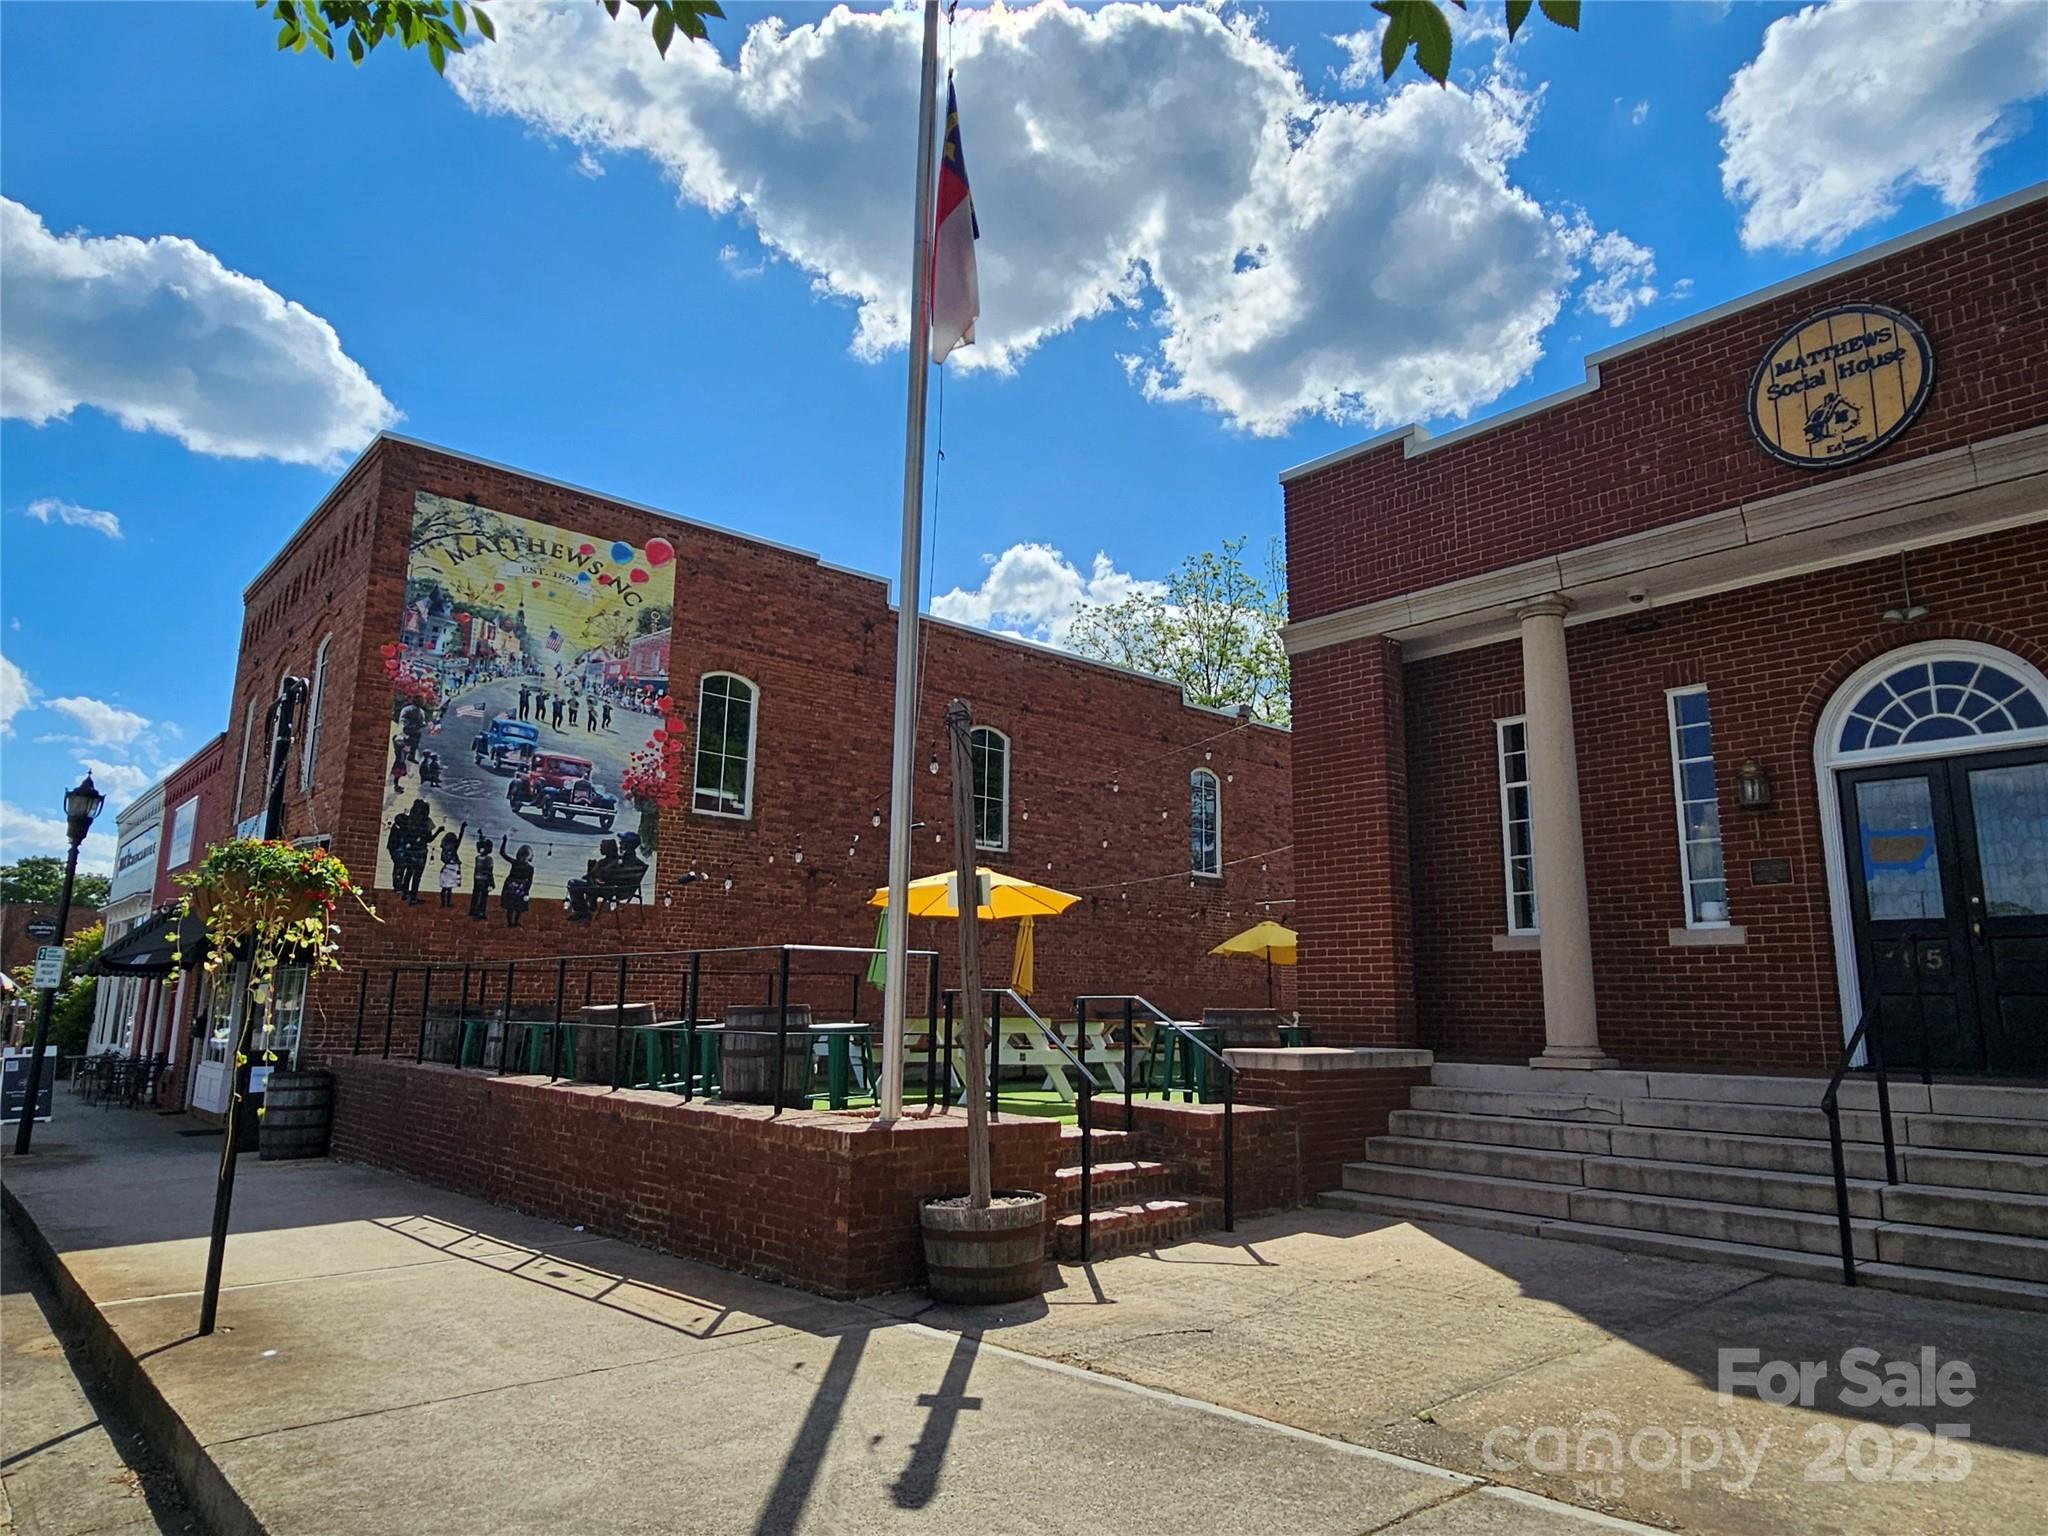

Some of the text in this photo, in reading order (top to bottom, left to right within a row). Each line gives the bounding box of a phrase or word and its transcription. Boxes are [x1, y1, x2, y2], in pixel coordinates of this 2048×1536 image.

[1775, 327, 1892, 377] MATTHEWS
[1767, 348, 1906, 400] Social House
[521, 565, 548, 575] EST.
[607, 575, 643, 607] NC
